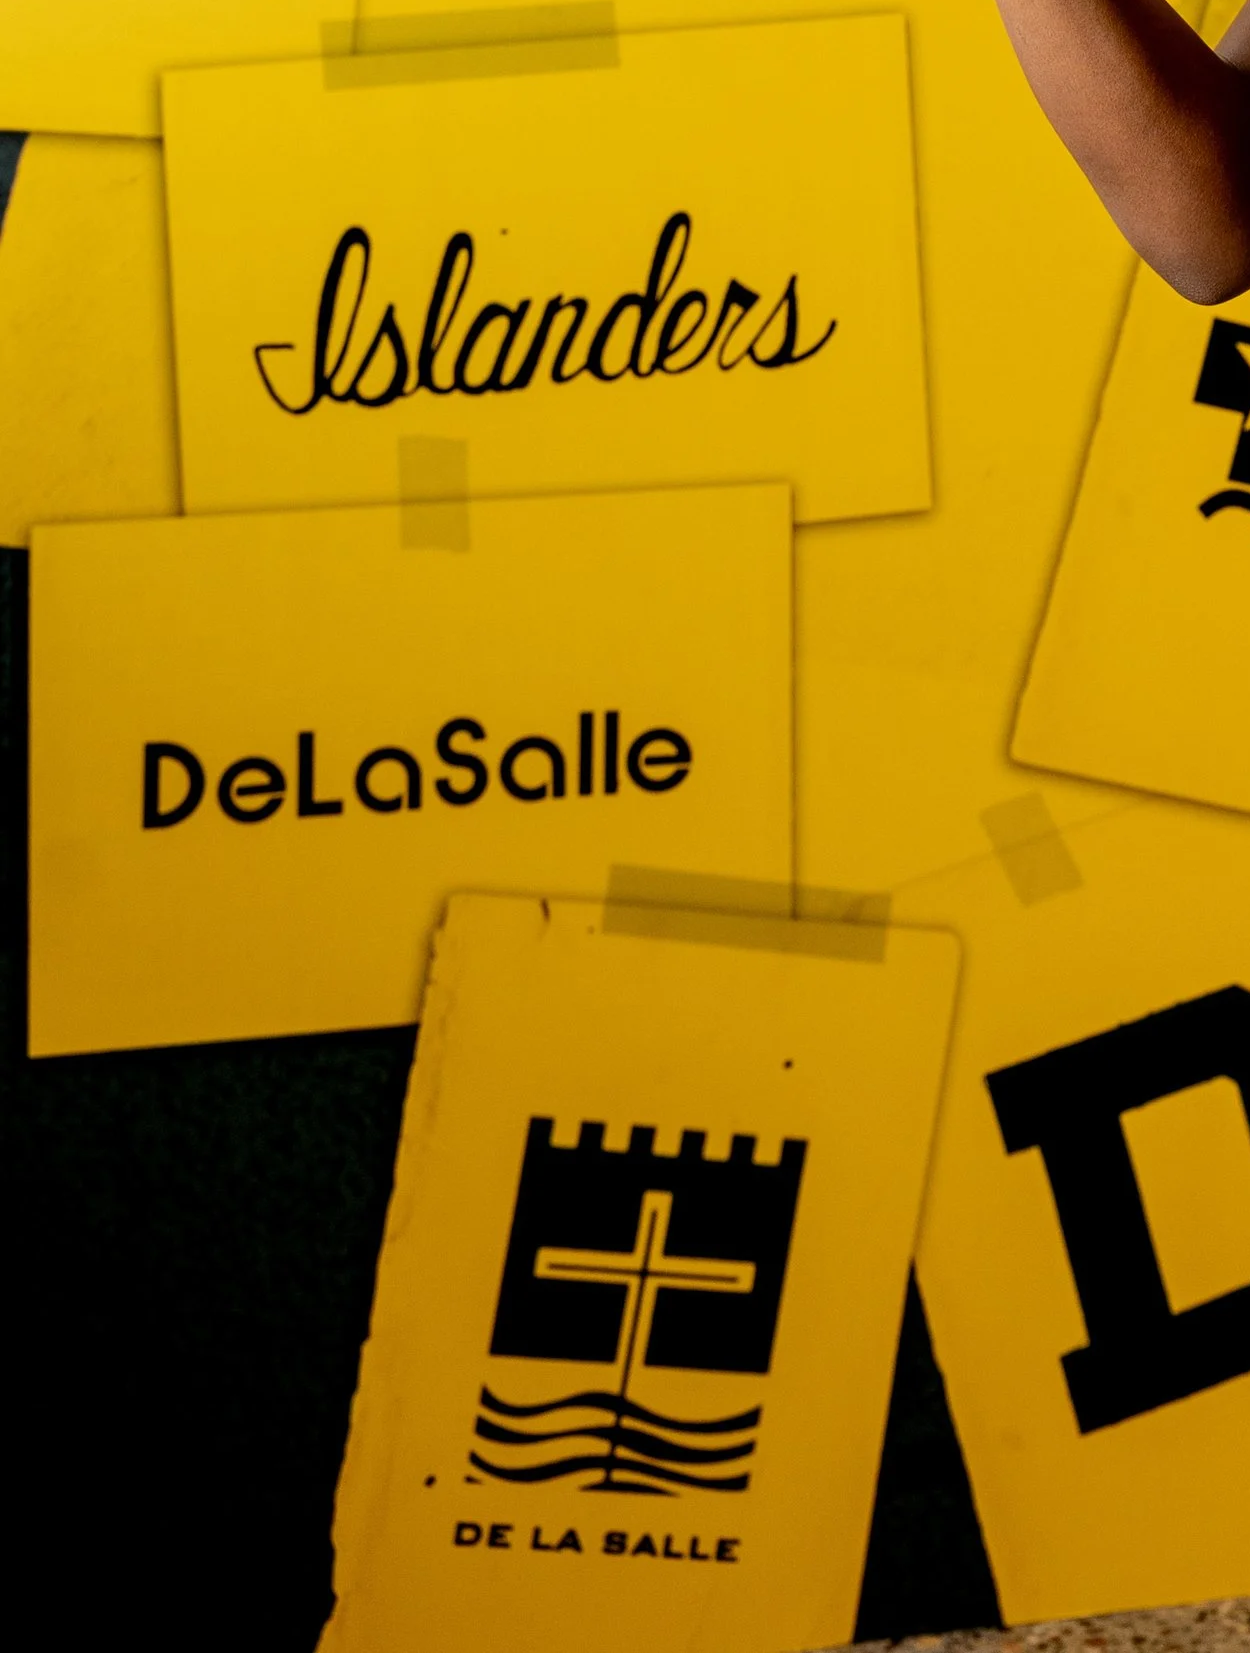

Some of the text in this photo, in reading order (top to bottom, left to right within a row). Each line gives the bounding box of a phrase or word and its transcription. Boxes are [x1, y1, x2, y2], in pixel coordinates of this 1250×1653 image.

[253, 211, 838, 414] Islanders
[142, 711, 693, 829] DeLaSalle
[453, 1520, 741, 1563] DE LA SALLE
